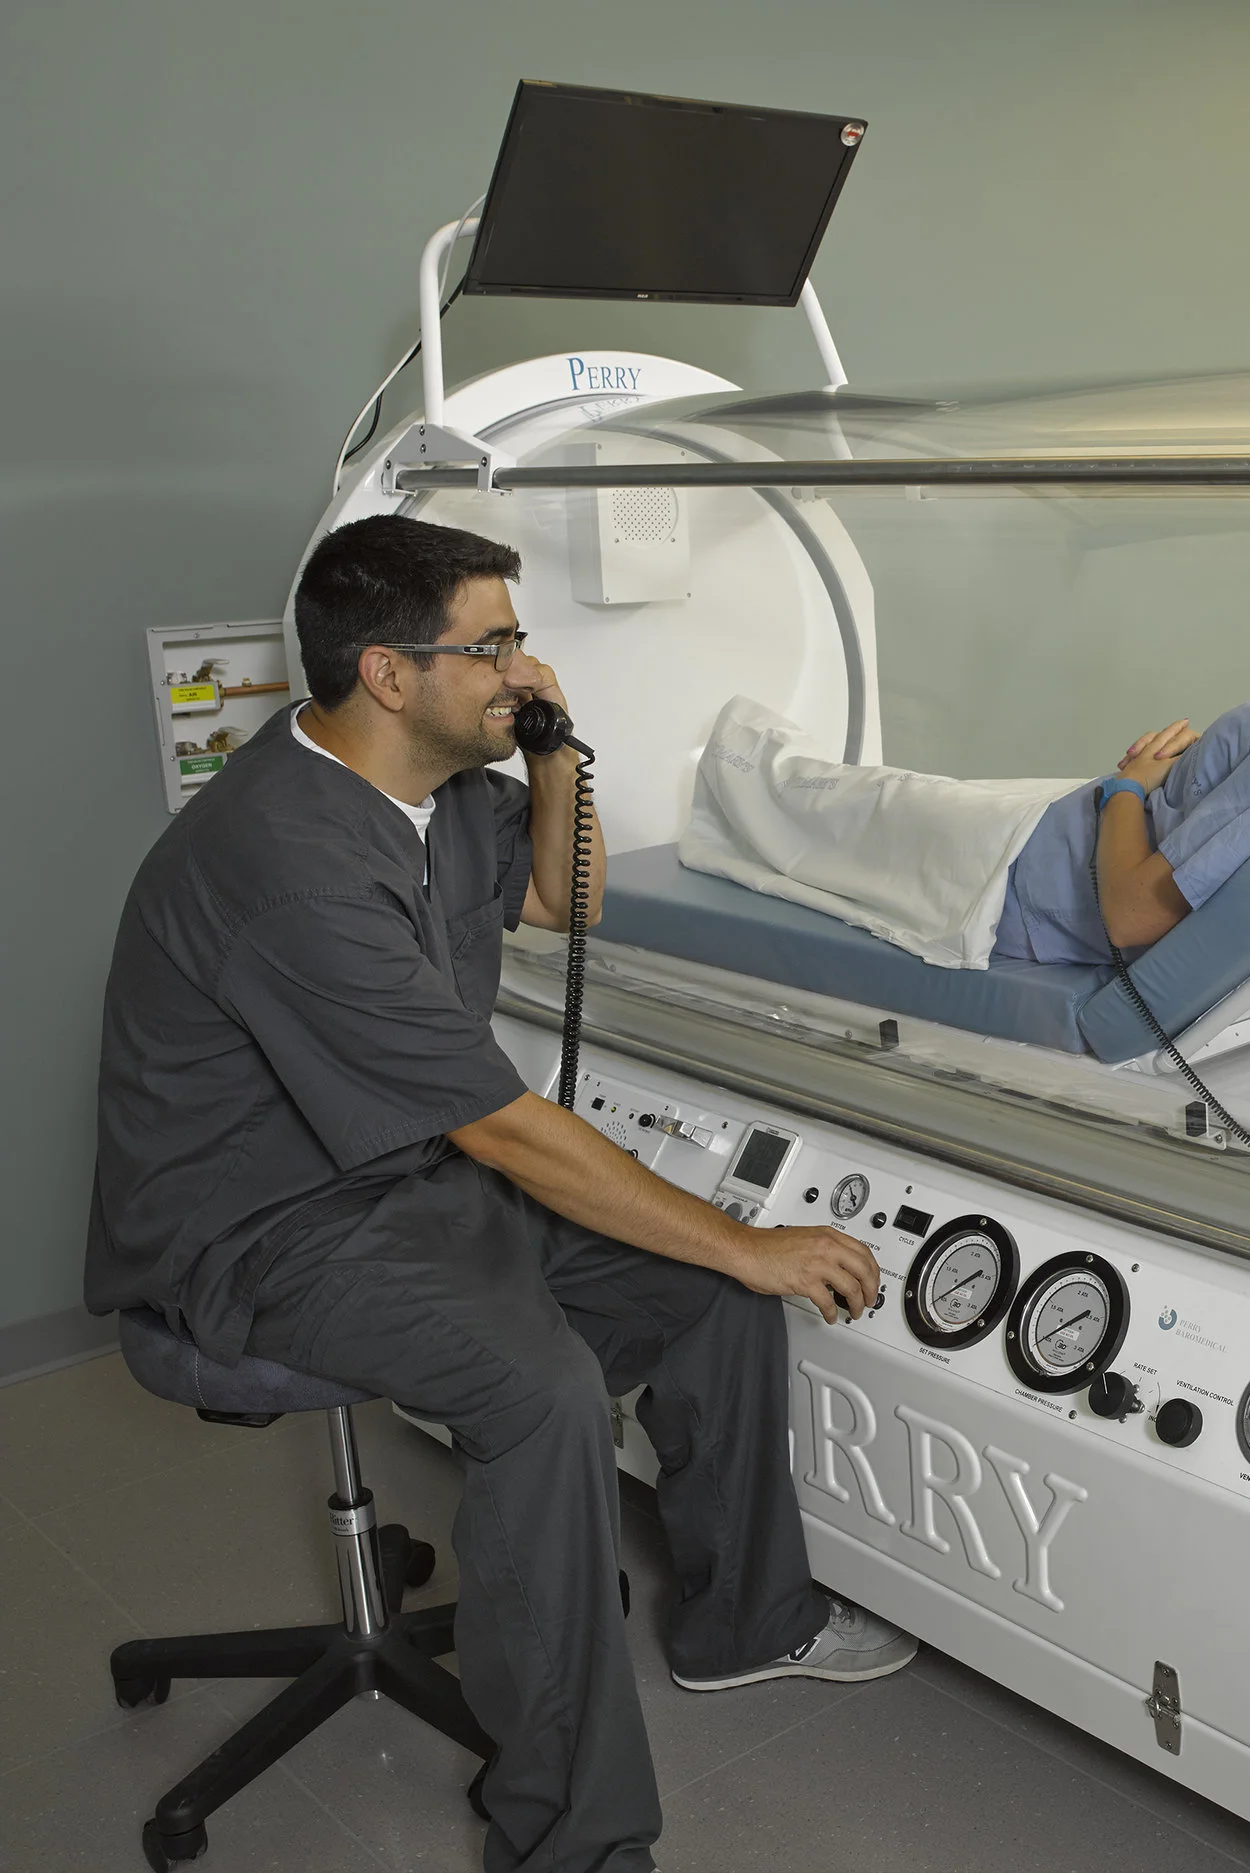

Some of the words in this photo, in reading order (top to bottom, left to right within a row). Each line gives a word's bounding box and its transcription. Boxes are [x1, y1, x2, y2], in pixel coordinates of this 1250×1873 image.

[898, 1236, 915, 1246] CYCLES
[880, 1267, 898, 1278] RESSURE
[1179, 1319, 1202, 1333] PERRY
[1175, 1328, 1228, 1354] BAROMEDICAL
[919, 1347, 928, 1355] SET
[927, 1350, 951, 1365] PRESSURE
[1133, 1361, 1149, 1373] RATE
[1146, 1366, 1158, 1376] SET
[1014, 1388, 1039, 1403] CHAMBER
[1037, 1397, 1064, 1413] PRESSURE
[1176, 1379, 1212, 1398] VENTILATION
[1208, 1391, 1235, 1407] CONTROL
